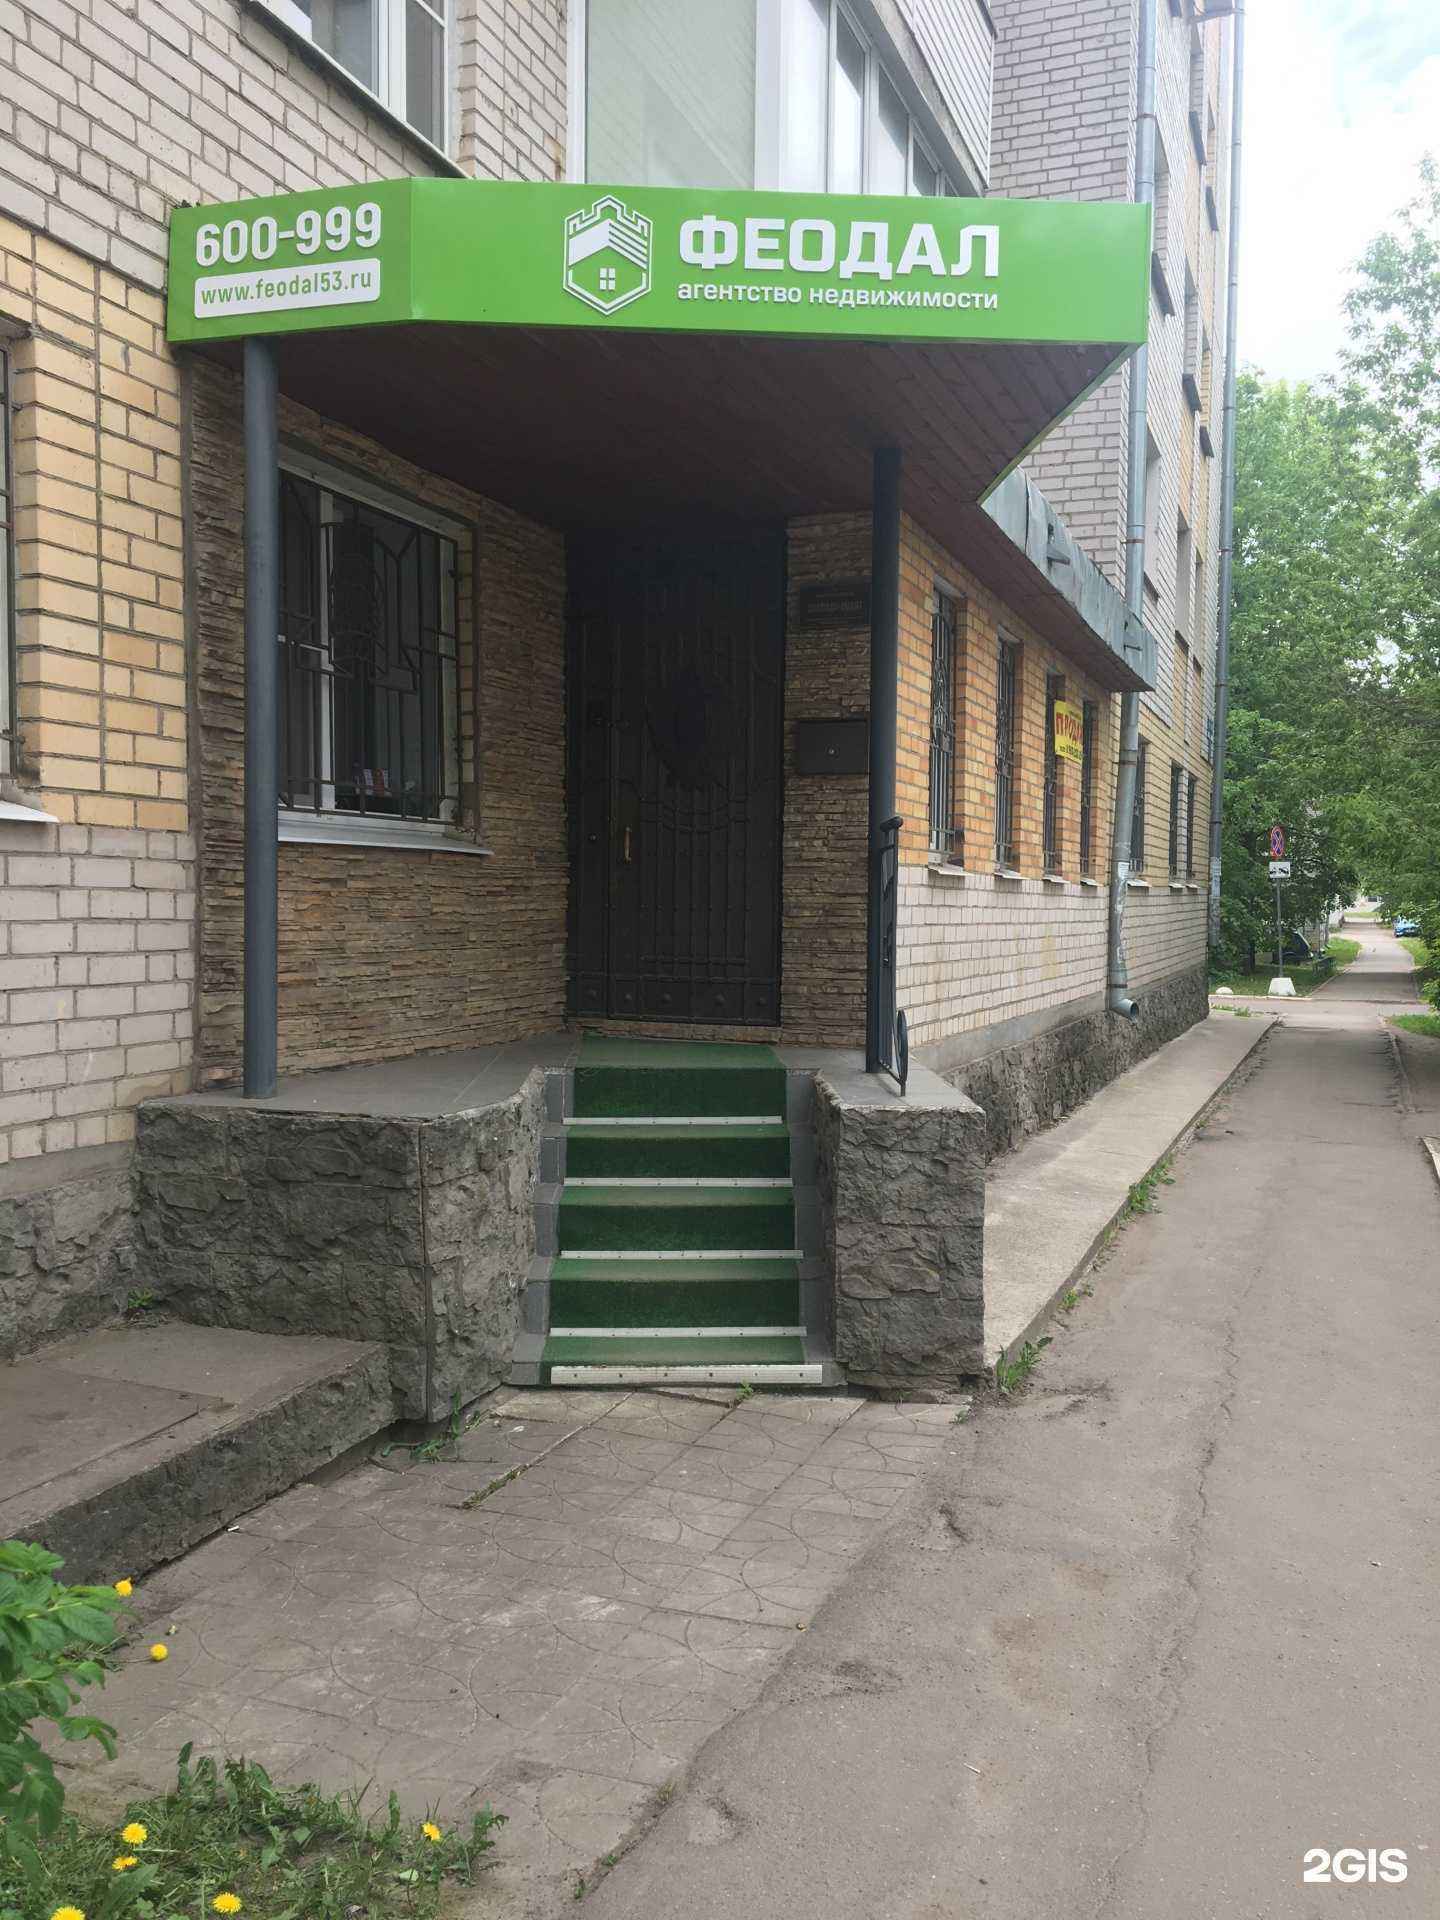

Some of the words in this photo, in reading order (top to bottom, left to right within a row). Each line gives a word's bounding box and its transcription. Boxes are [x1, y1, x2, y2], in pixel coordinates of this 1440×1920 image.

[196, 202, 381, 266] 600-999
[679, 215, 1000, 281] ФЕОДАЛ
[201, 272, 372, 304] www.feodal53.ru
[678, 283, 801, 303] агентство
[809, 286, 998, 309] недвижимости
